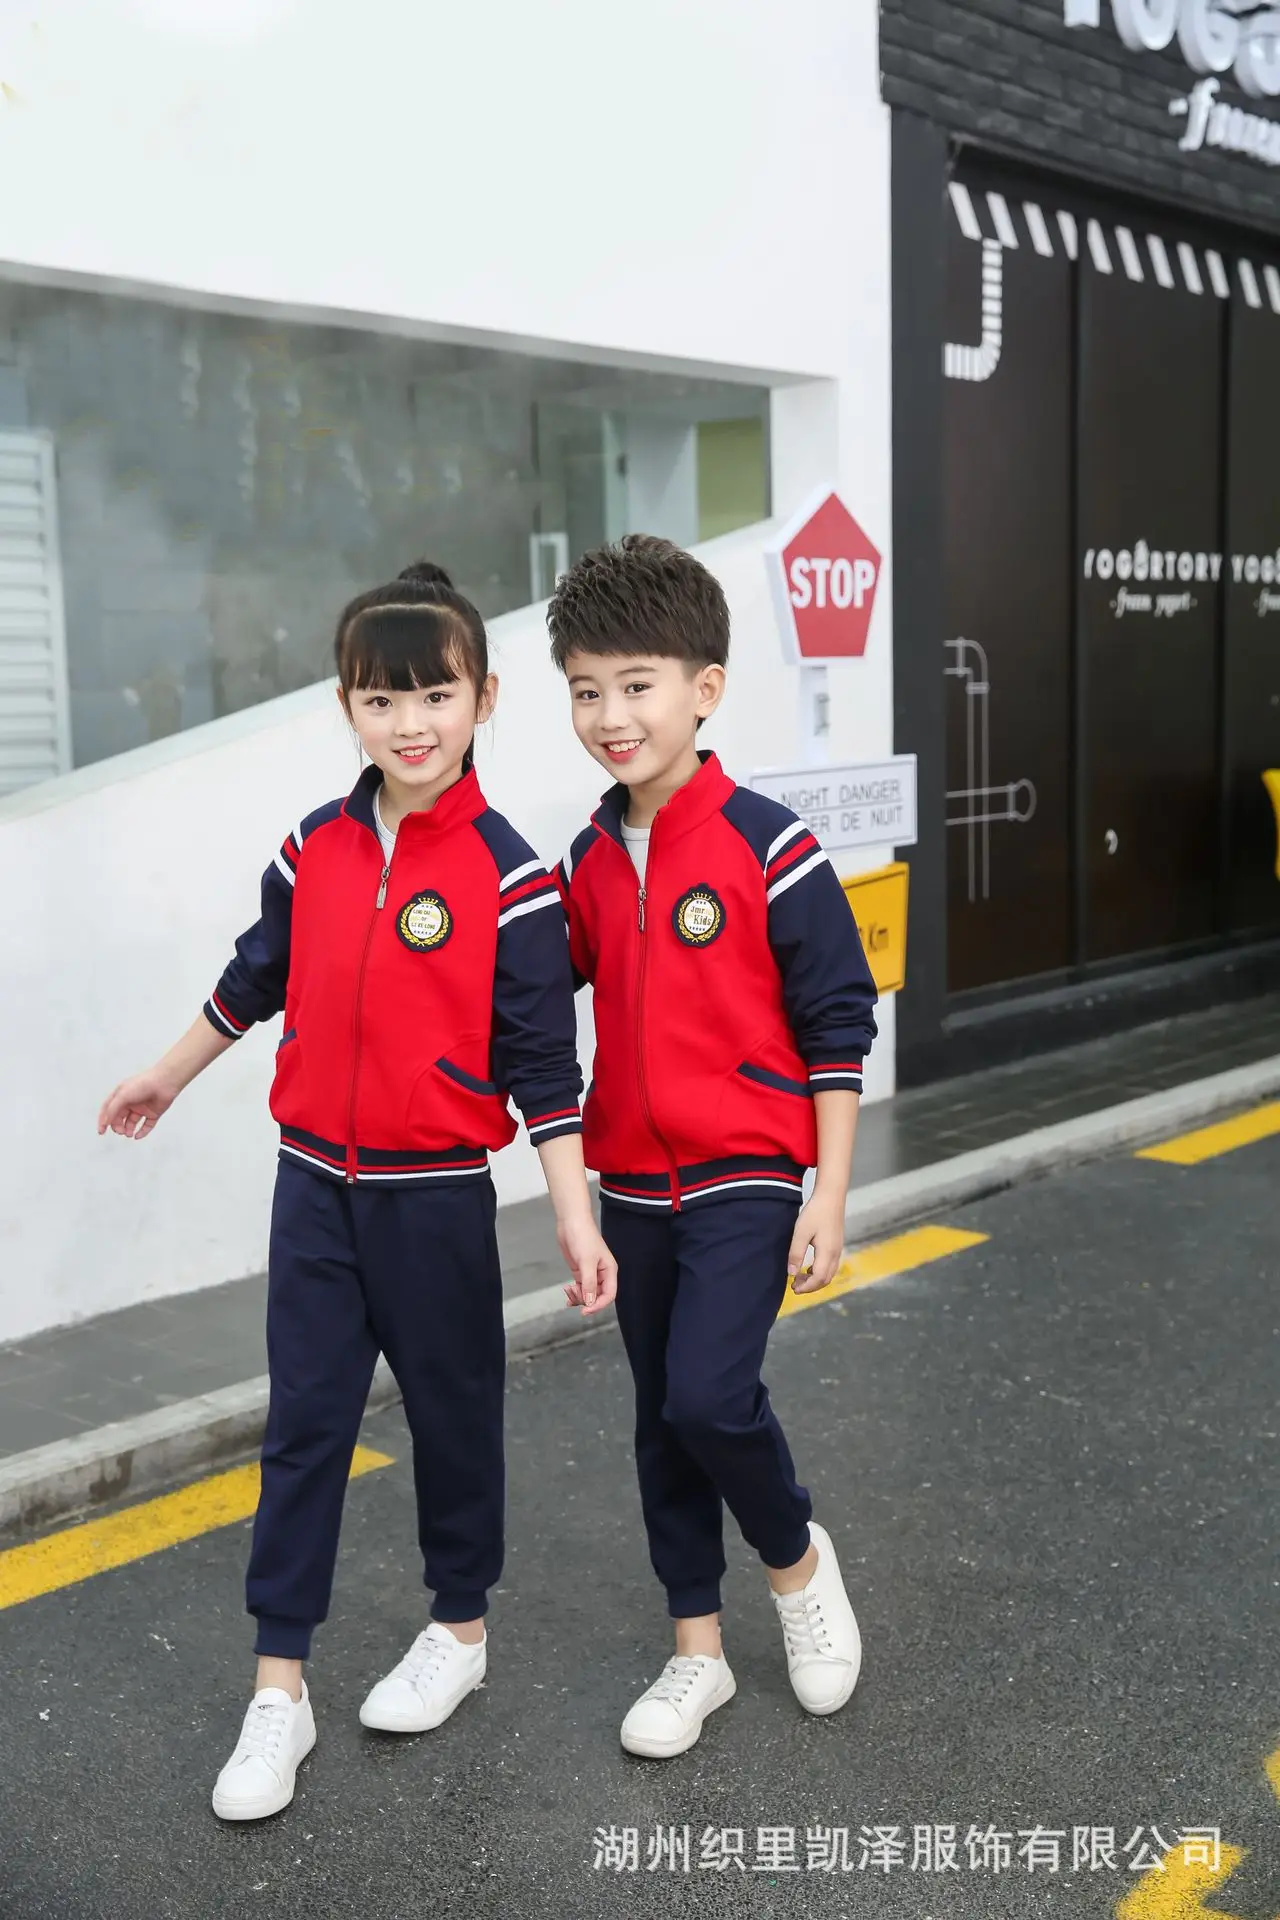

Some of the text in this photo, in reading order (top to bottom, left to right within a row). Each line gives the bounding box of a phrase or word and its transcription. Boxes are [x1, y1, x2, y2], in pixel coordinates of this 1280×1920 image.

[790, 556, 876, 609] STOP
[839, 779, 901, 803] DANGER
[841, 812, 861, 832] DE
[871, 806, 903, 827] NUIT
[693, 914, 712, 926] Kids
